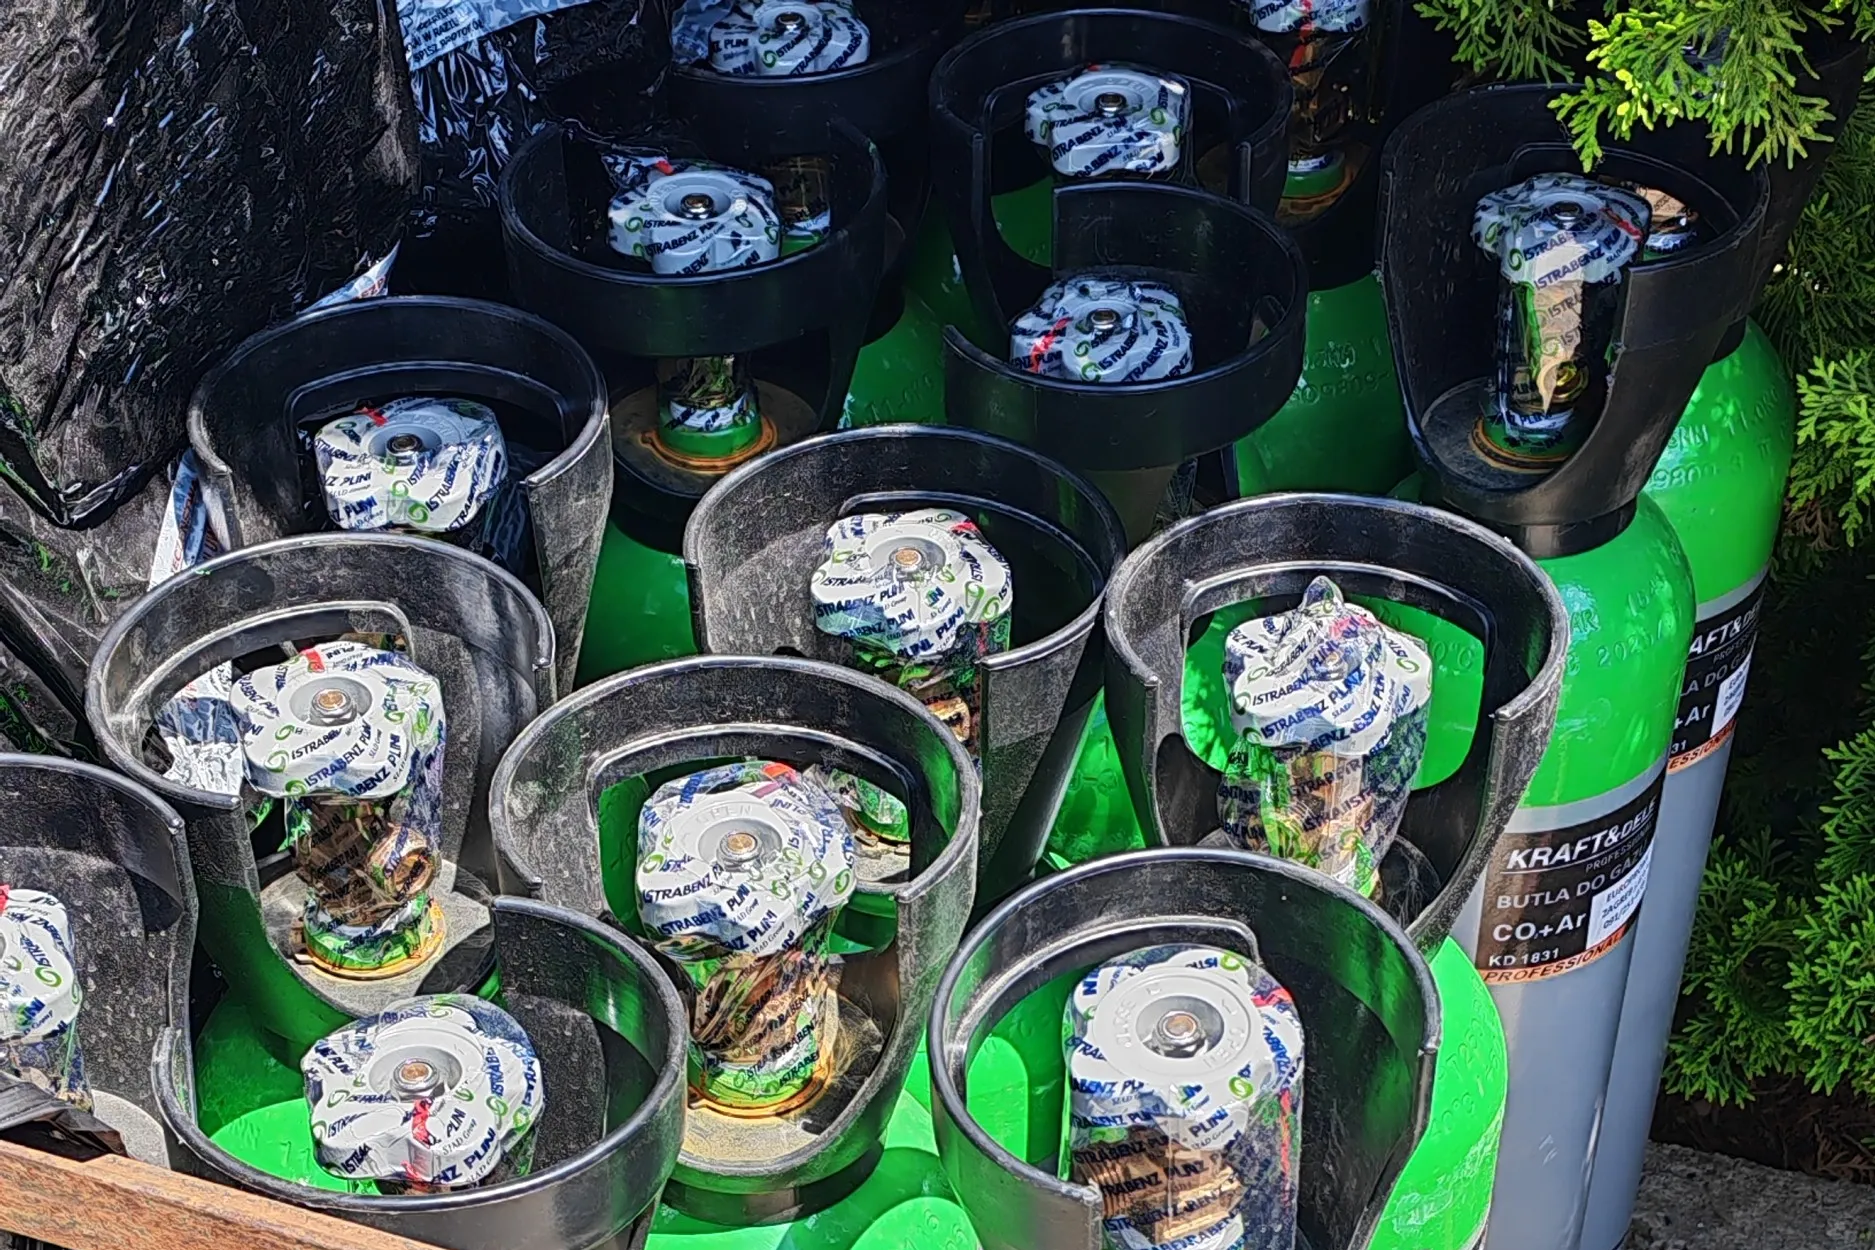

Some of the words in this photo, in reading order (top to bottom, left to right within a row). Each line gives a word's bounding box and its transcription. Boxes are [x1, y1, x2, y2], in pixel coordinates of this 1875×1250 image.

[1673, 703, 1712, 730] +Ar
[1496, 887, 1570, 910] BUTLA
[1576, 874, 1605, 897] DO
[657, 902, 728, 936] ISTRABENZ
[1483, 924, 1628, 983] PROFESSIONAL
[1488, 954, 1516, 968] KD
[1521, 947, 1560, 966] 1831
[1188, 1107, 1230, 1139] PLINI
[463, 1126, 498, 1170] PLINI
